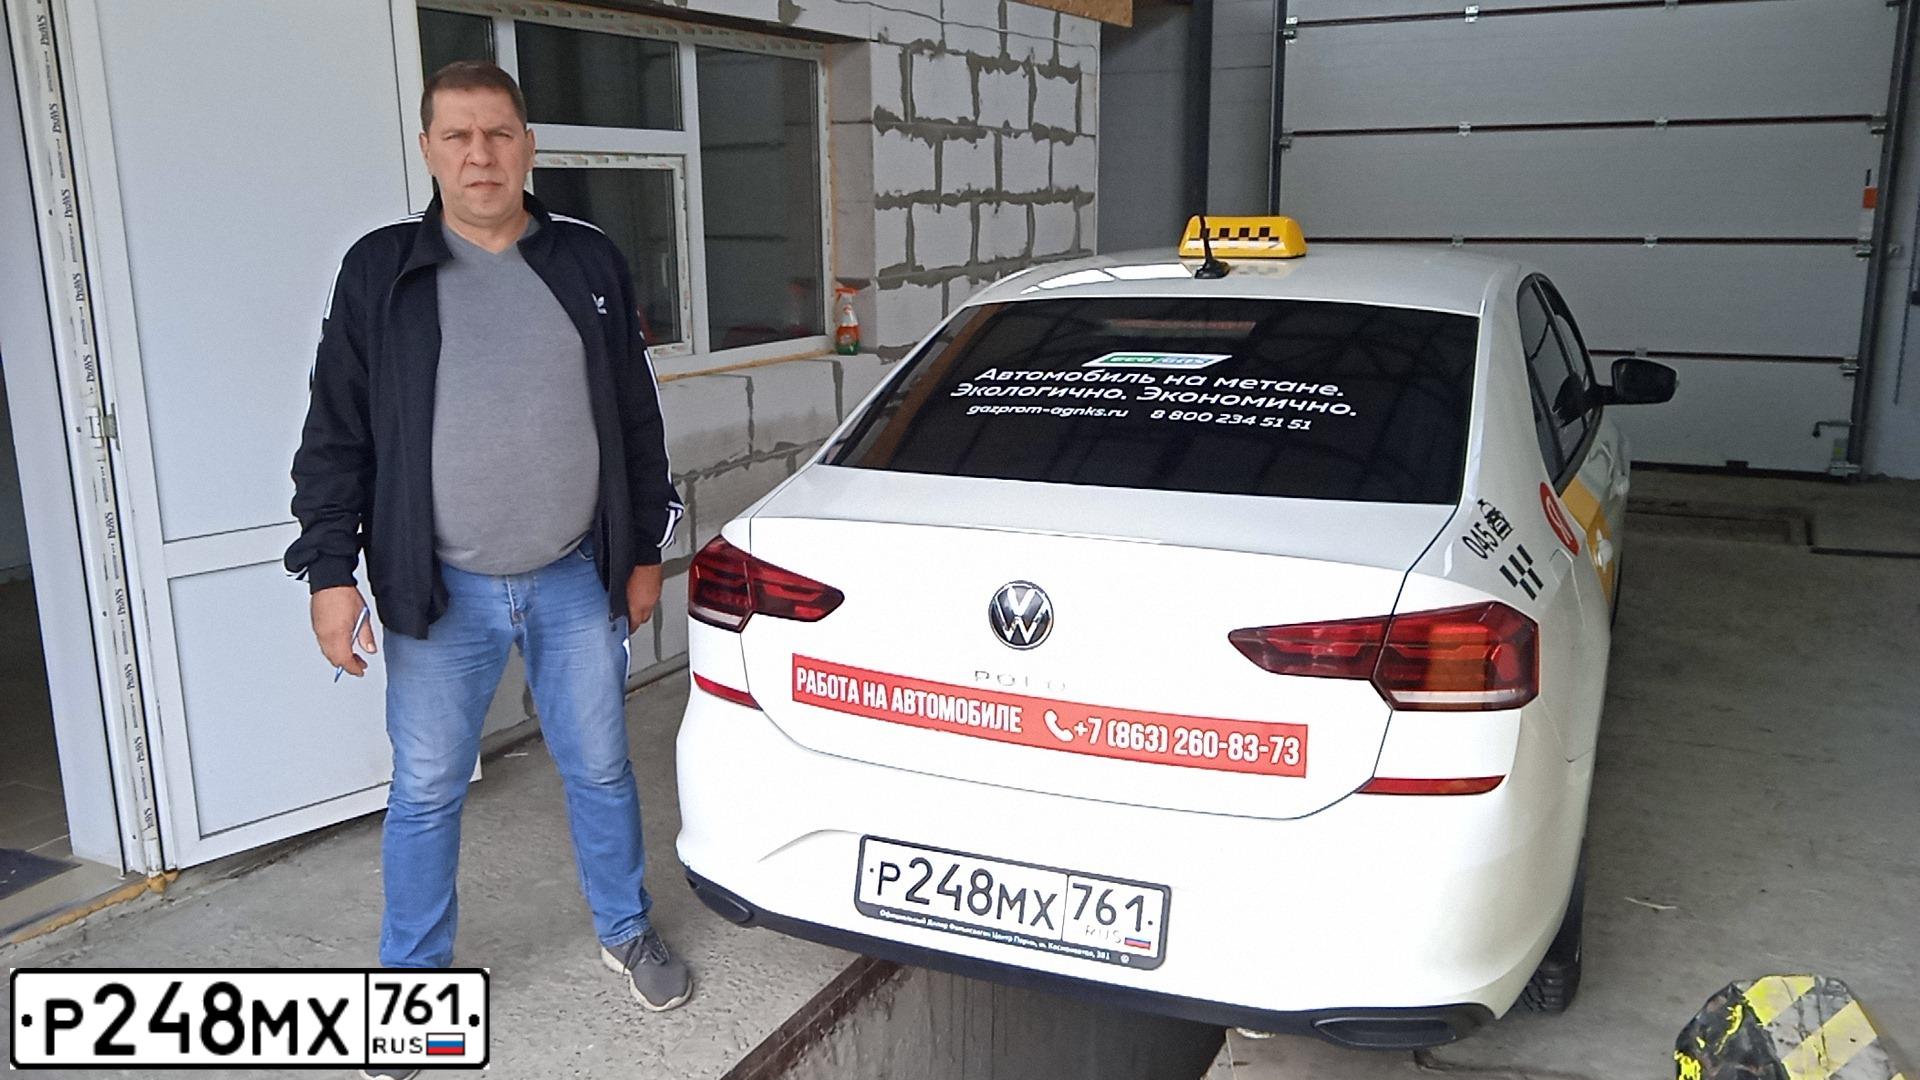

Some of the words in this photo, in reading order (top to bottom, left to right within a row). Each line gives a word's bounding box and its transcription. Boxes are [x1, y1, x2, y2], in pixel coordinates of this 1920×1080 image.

[974, 368, 1156, 384] Автомобиль
[1163, 374, 1207, 386] на
[1213, 376, 1344, 397] метане.
[950, 383, 1127, 400] Экологично.
[1136, 387, 1357, 416] Экономично.
[966, 405, 1129, 418] gazprom-agnks.ru
[1150, 410, 1165, 419] 8
[1168, 410, 1213, 422] 800
[1215, 413, 1257, 426] 234
[1260, 417, 1284, 428] 51
[1287, 419, 1312, 430] 51
[1462, 522, 1498, 559] 045
[796, 667, 859, 704] РАБОТА
[863, 681, 888, 709] НА
[891, 687, 1023, 733] АВТОМОБИЛЕ
[1074, 717, 1102, 744] +7
[1106, 720, 1168, 753] (863)
[1173, 728, 1300, 765] 260-83-73
[1073, 883, 1144, 932] 761
